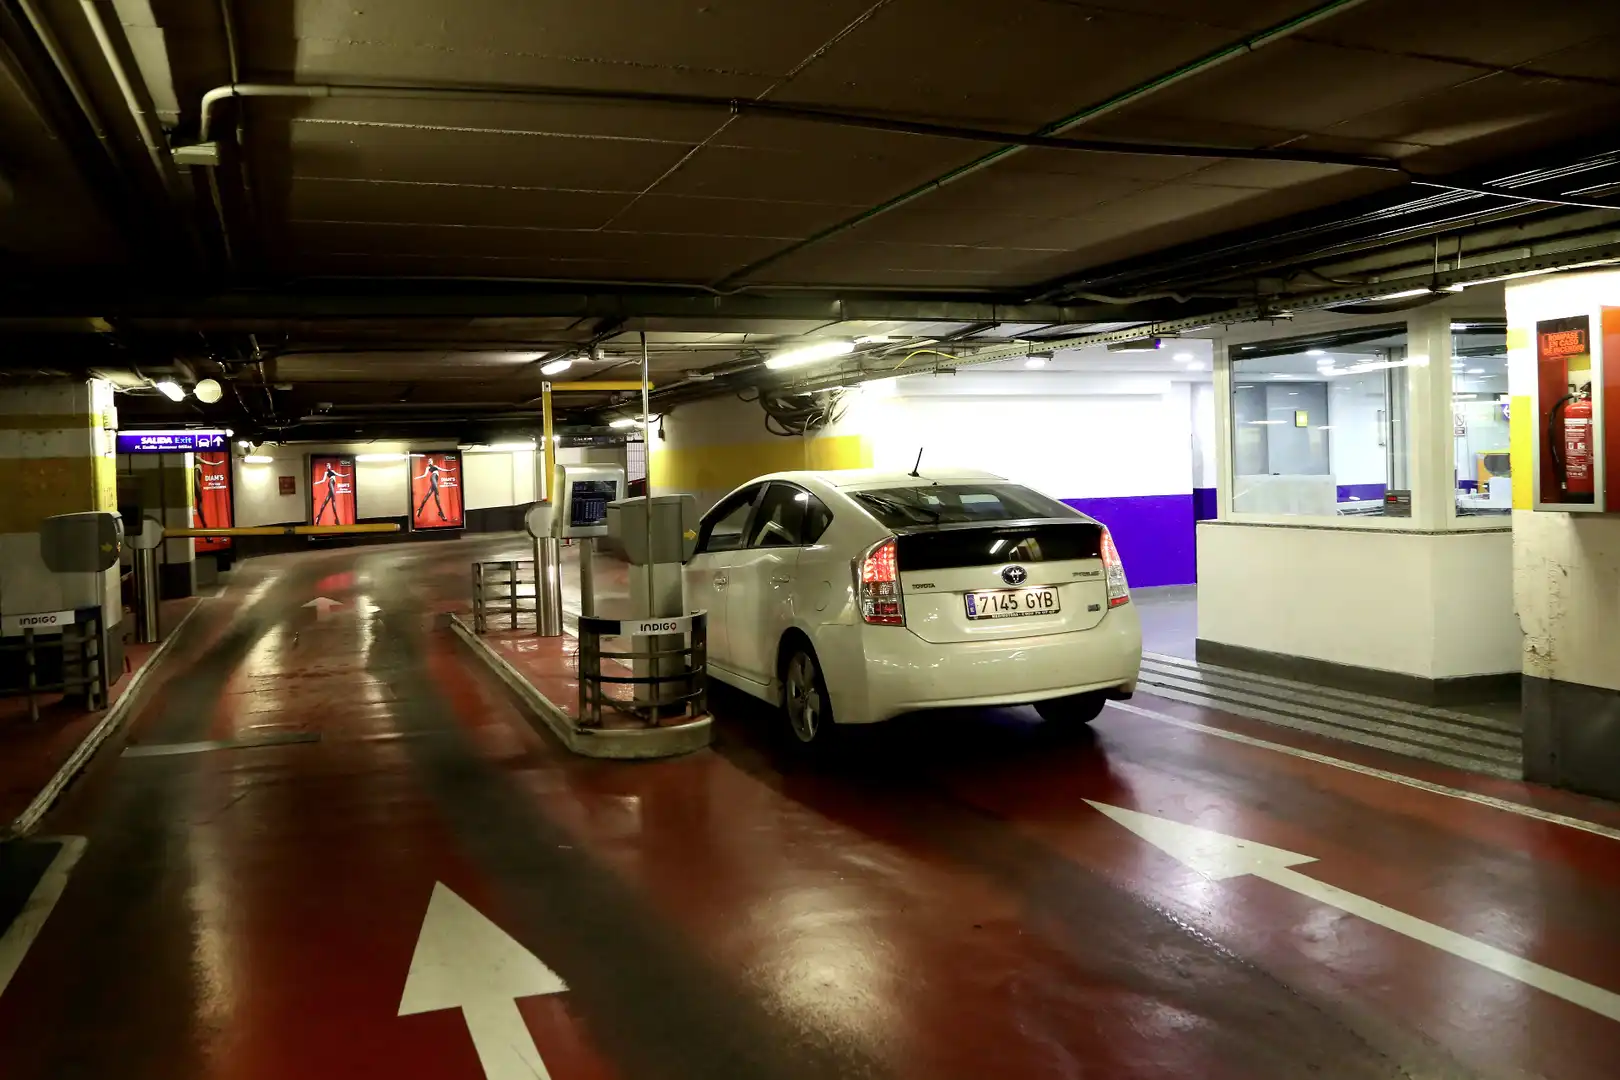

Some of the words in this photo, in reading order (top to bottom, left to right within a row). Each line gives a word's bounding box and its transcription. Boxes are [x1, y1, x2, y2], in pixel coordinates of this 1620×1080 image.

[1559, 338, 1579, 347] CASO
[979, 593, 1018, 613] 7145
[1025, 591, 1054, 609] GYB
[19, 616, 57, 625] INDIGO
[640, 622, 677, 632] INDIGO
